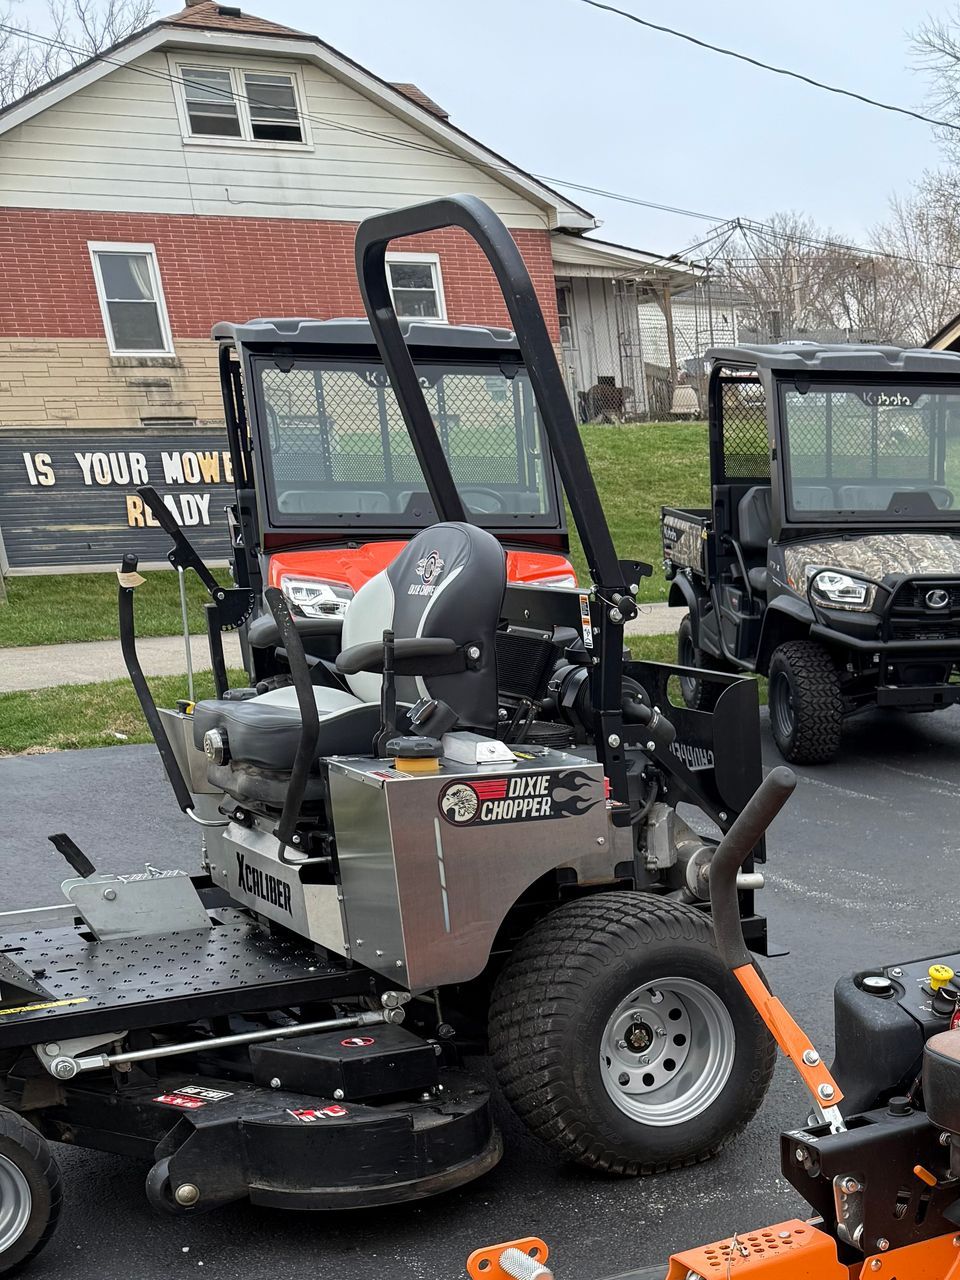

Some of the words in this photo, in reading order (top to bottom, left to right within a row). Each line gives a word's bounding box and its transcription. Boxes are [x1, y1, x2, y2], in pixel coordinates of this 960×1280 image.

[863, 392, 910, 406] Kubota
[23, 452, 56, 486] IS
[74, 452, 149, 486] YOUR
[161, 451, 247, 485] MOWE
[508, 775, 551, 797] DIXIE
[480, 797, 551, 821] CHOPPER
